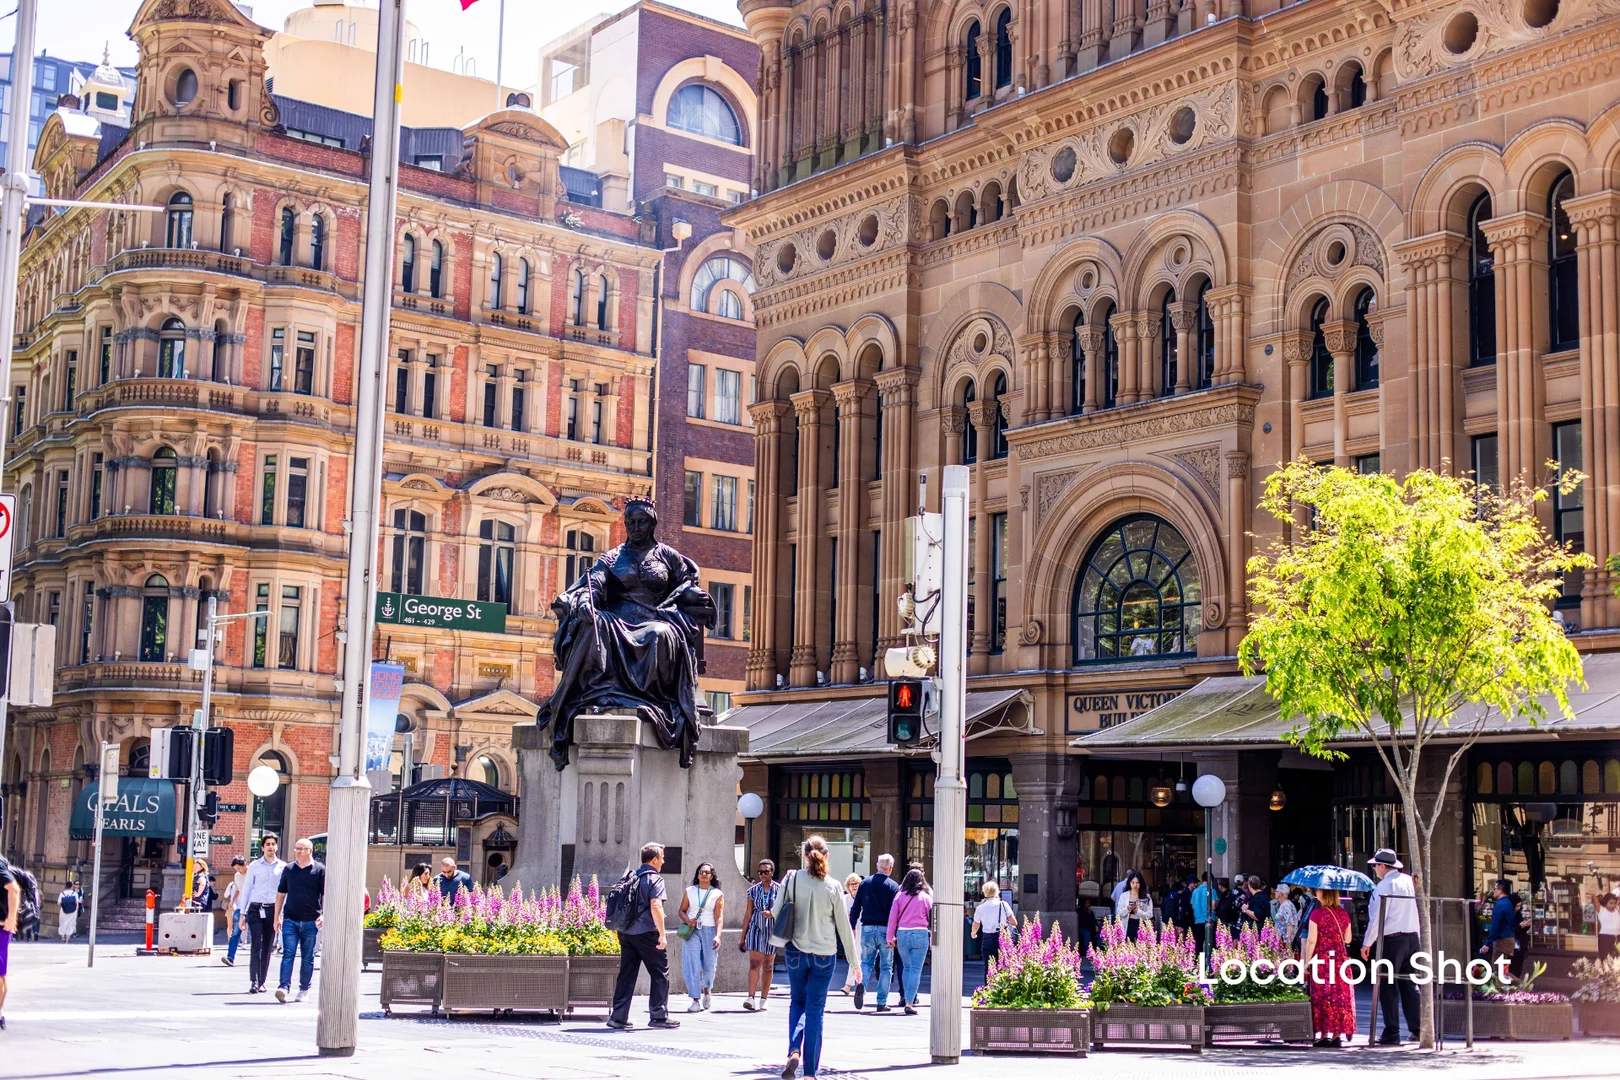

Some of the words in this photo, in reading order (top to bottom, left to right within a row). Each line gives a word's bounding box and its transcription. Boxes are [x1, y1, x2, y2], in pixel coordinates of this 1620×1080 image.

[405, 598, 462, 621] George
[466, 604, 482, 620] St
[1073, 695, 1119, 713] QUEEN
[103, 817, 146, 831] EARLS
